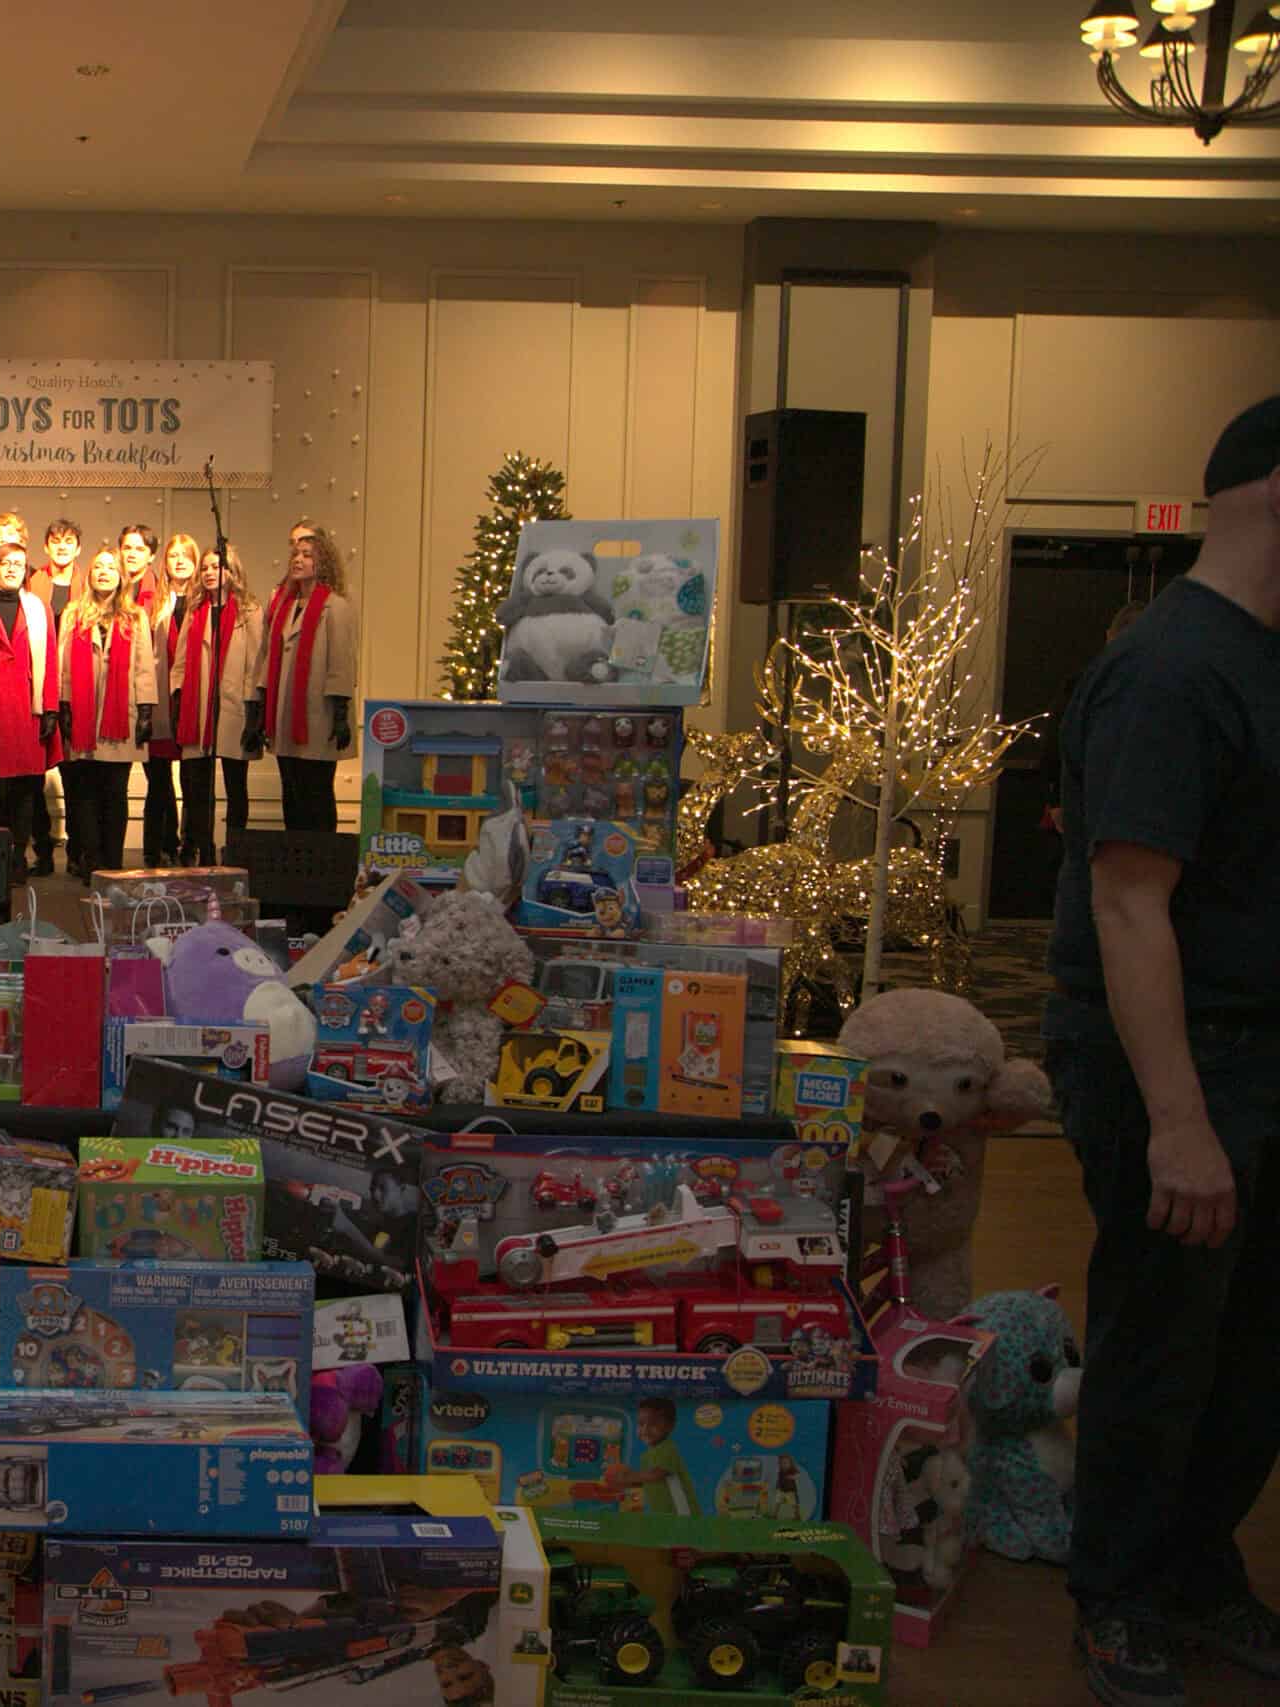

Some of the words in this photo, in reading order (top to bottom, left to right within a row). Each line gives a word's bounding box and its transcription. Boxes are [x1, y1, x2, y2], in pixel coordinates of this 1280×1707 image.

[62, 409, 95, 430] FOR
[96, 397, 181, 434] TOTS
[82, 440, 182, 471] Breakfast
[1147, 504, 1182, 530] EXIT
[370, 834, 422, 853] Little
[194, 1081, 370, 1154] LASER
[373, 1128, 412, 1165] X
[149, 1148, 257, 1176] Hippos
[473, 1360, 578, 1379] ULTIMATE
[583, 1362, 631, 1379] FIRE
[635, 1363, 708, 1381] TRUCK
[788, 1369, 849, 1387] ULTIMATE
[431, 1404, 488, 1420] vtech
[249, 1448, 310, 1463] playmobil
[160, 1565, 288, 1581] RAPIDSTRIKE
